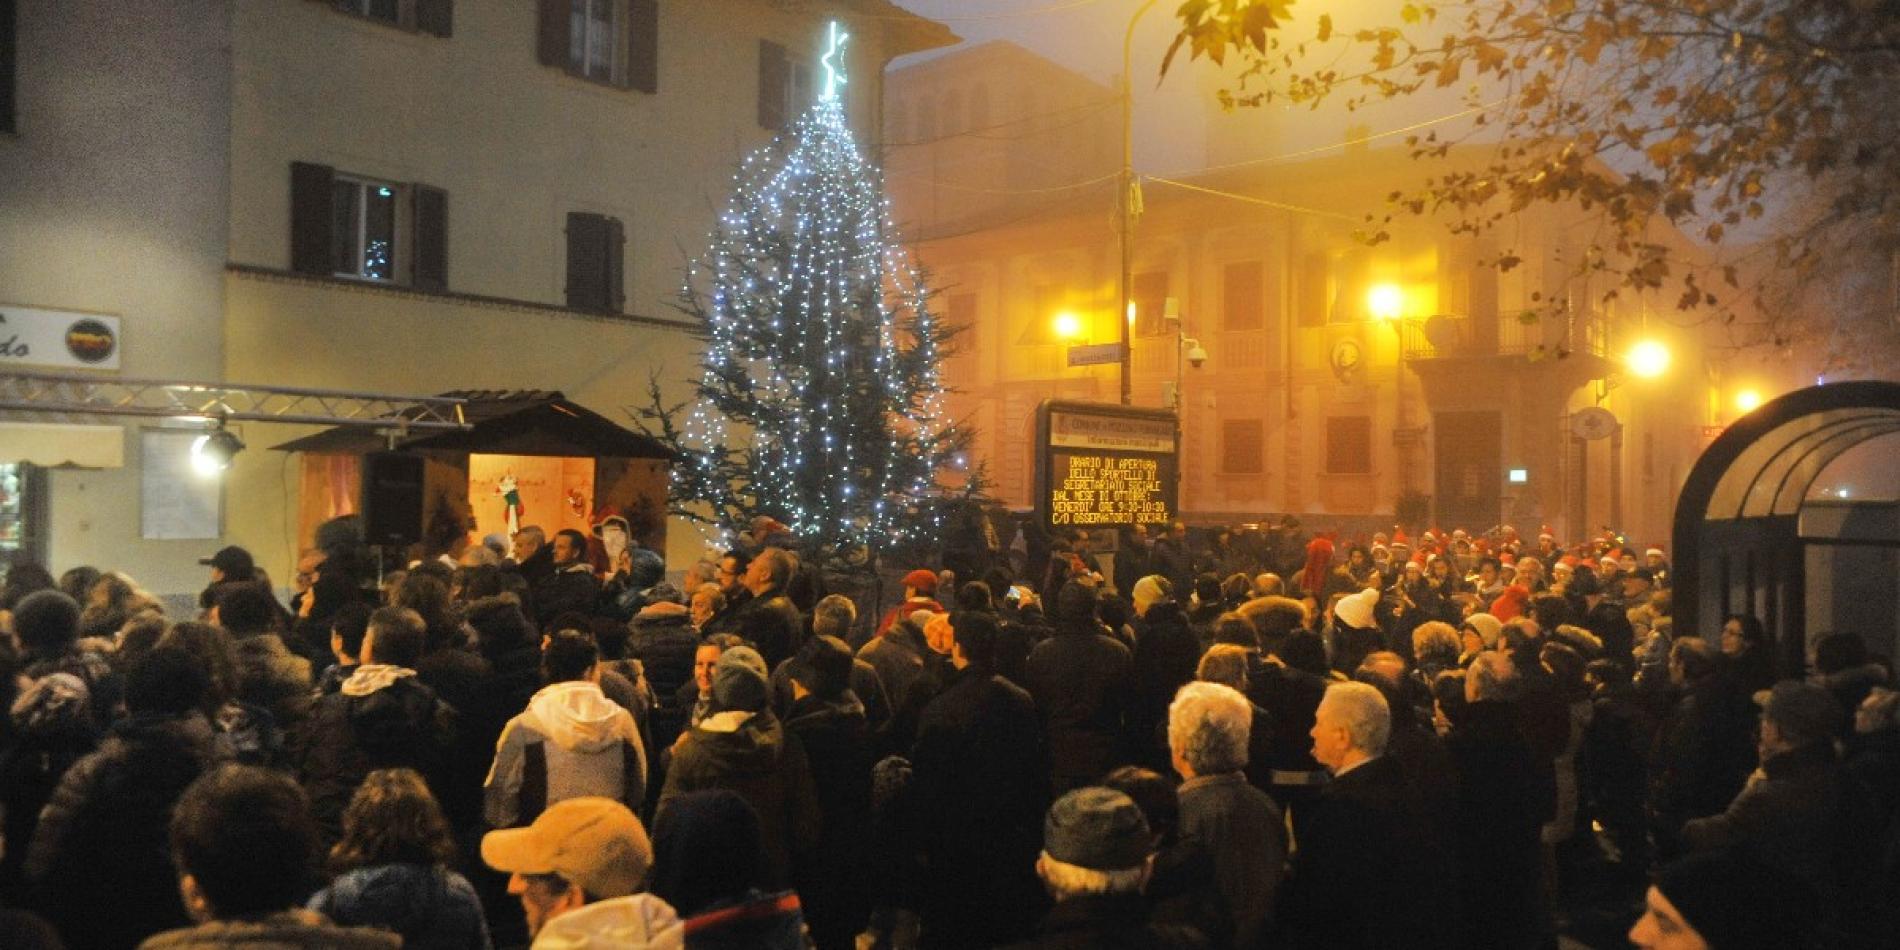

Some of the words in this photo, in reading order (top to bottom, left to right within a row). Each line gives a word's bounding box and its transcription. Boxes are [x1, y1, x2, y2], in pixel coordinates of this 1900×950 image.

[1069, 457, 1100, 468] ORARIO
[1105, 457, 1114, 469] DI
[1119, 458, 1157, 471] APERTURA
[1069, 468, 1096, 479] DELLO
[1100, 469, 1144, 480] SPORTELLO
[1147, 470, 1155, 481] DI
[1064, 479, 1125, 490] SEGRETARIATO
[1128, 480, 1161, 491] SOCIALE
[1053, 490, 1070, 501] DAL
[1074, 490, 1095, 501] MESE
[1100, 490, 1109, 501] DI
[1052, 501, 1093, 512] VENERDI'
[1098, 502, 1114, 512] ORE
[1052, 513, 1070, 524] C/O
[1073, 513, 1133, 524] OSSERVATORIO
[1137, 513, 1169, 524] SOCIALE
